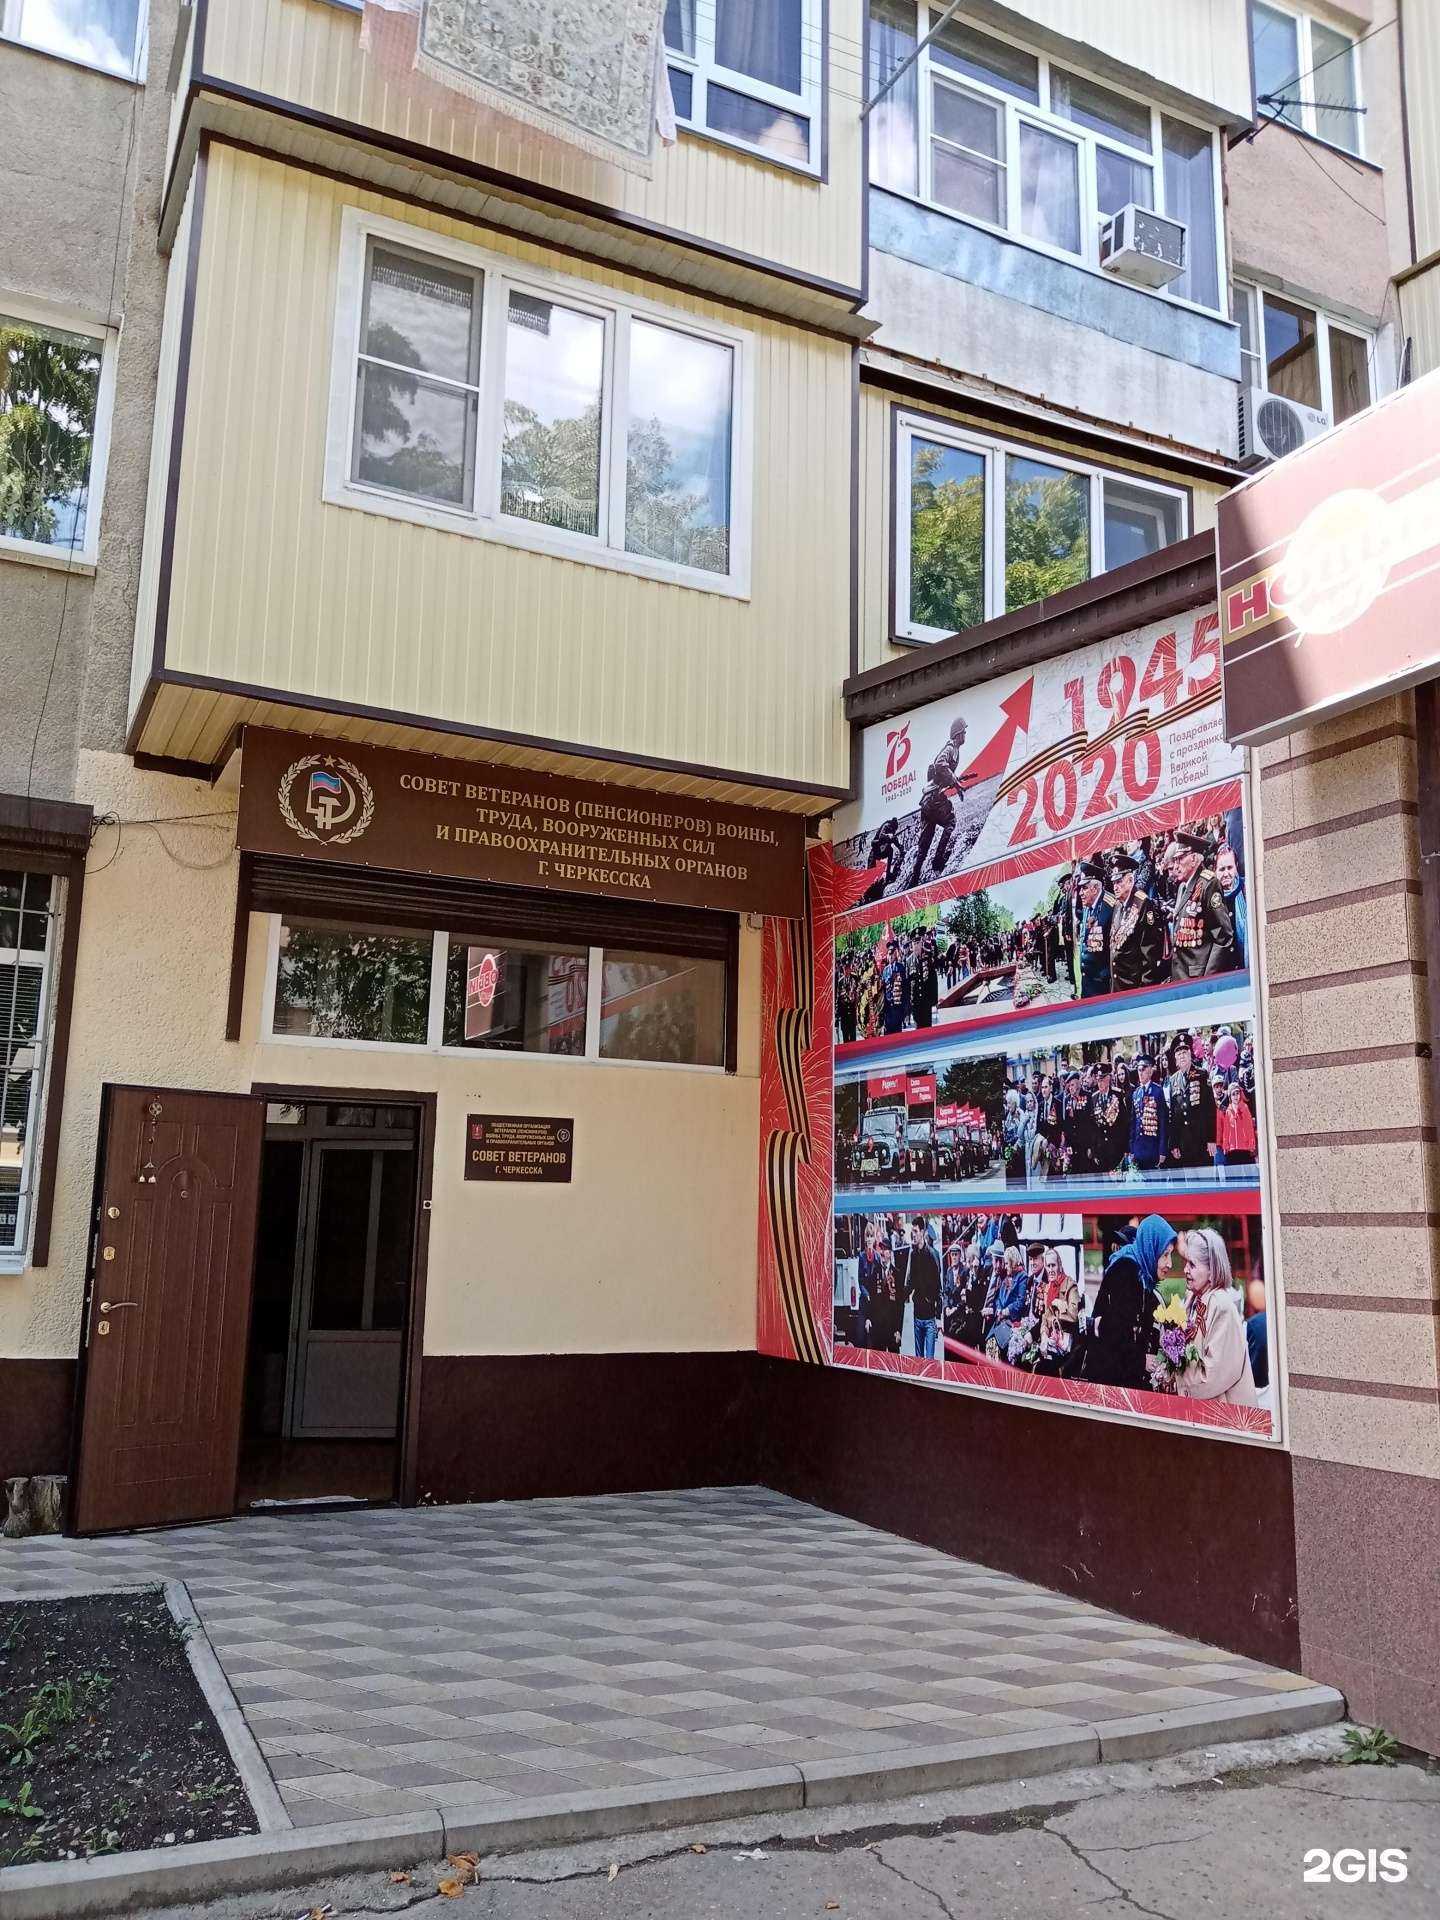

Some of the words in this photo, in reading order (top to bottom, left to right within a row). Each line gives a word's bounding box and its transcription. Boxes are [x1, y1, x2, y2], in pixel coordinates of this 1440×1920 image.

[1064, 612, 1222, 733] 1945
[1169, 718, 1224, 745] Поздравляе
[1170, 751, 1208, 774] Великой
[1171, 765, 1209, 788] Победы!
[881, 770, 917, 796] ПОБЕДА!
[1006, 729, 1162, 847] 2020
[400, 774, 461, 797] СОВЕТ
[465, 783, 571, 813] ВЕТЕРАНОВ
[574, 800, 712, 838] (ПЕНСИОНЕРОВ)
[476, 807, 538, 833] ТРУДА,
[542, 818, 679, 850] ВООРУЖЕННЫХ
[682, 838, 716, 856] СИЛ
[435, 824, 450, 841] И
[454, 827, 671, 870] ПРАВООХРАНИТЕЛЬНЫХ
[674, 857, 748, 880] ОРГАНОВ
[537, 860, 549, 875] Г.
[554, 862, 652, 889] ЧЕРКЕССКА
[472, 1150, 506, 1162] СОВЕТ
[509, 1151, 566, 1164] ВЕТЕРАНОВ
[495, 1165, 501, 1174] Г.
[503, 1165, 543, 1175] ЧЕРКЕССКА
